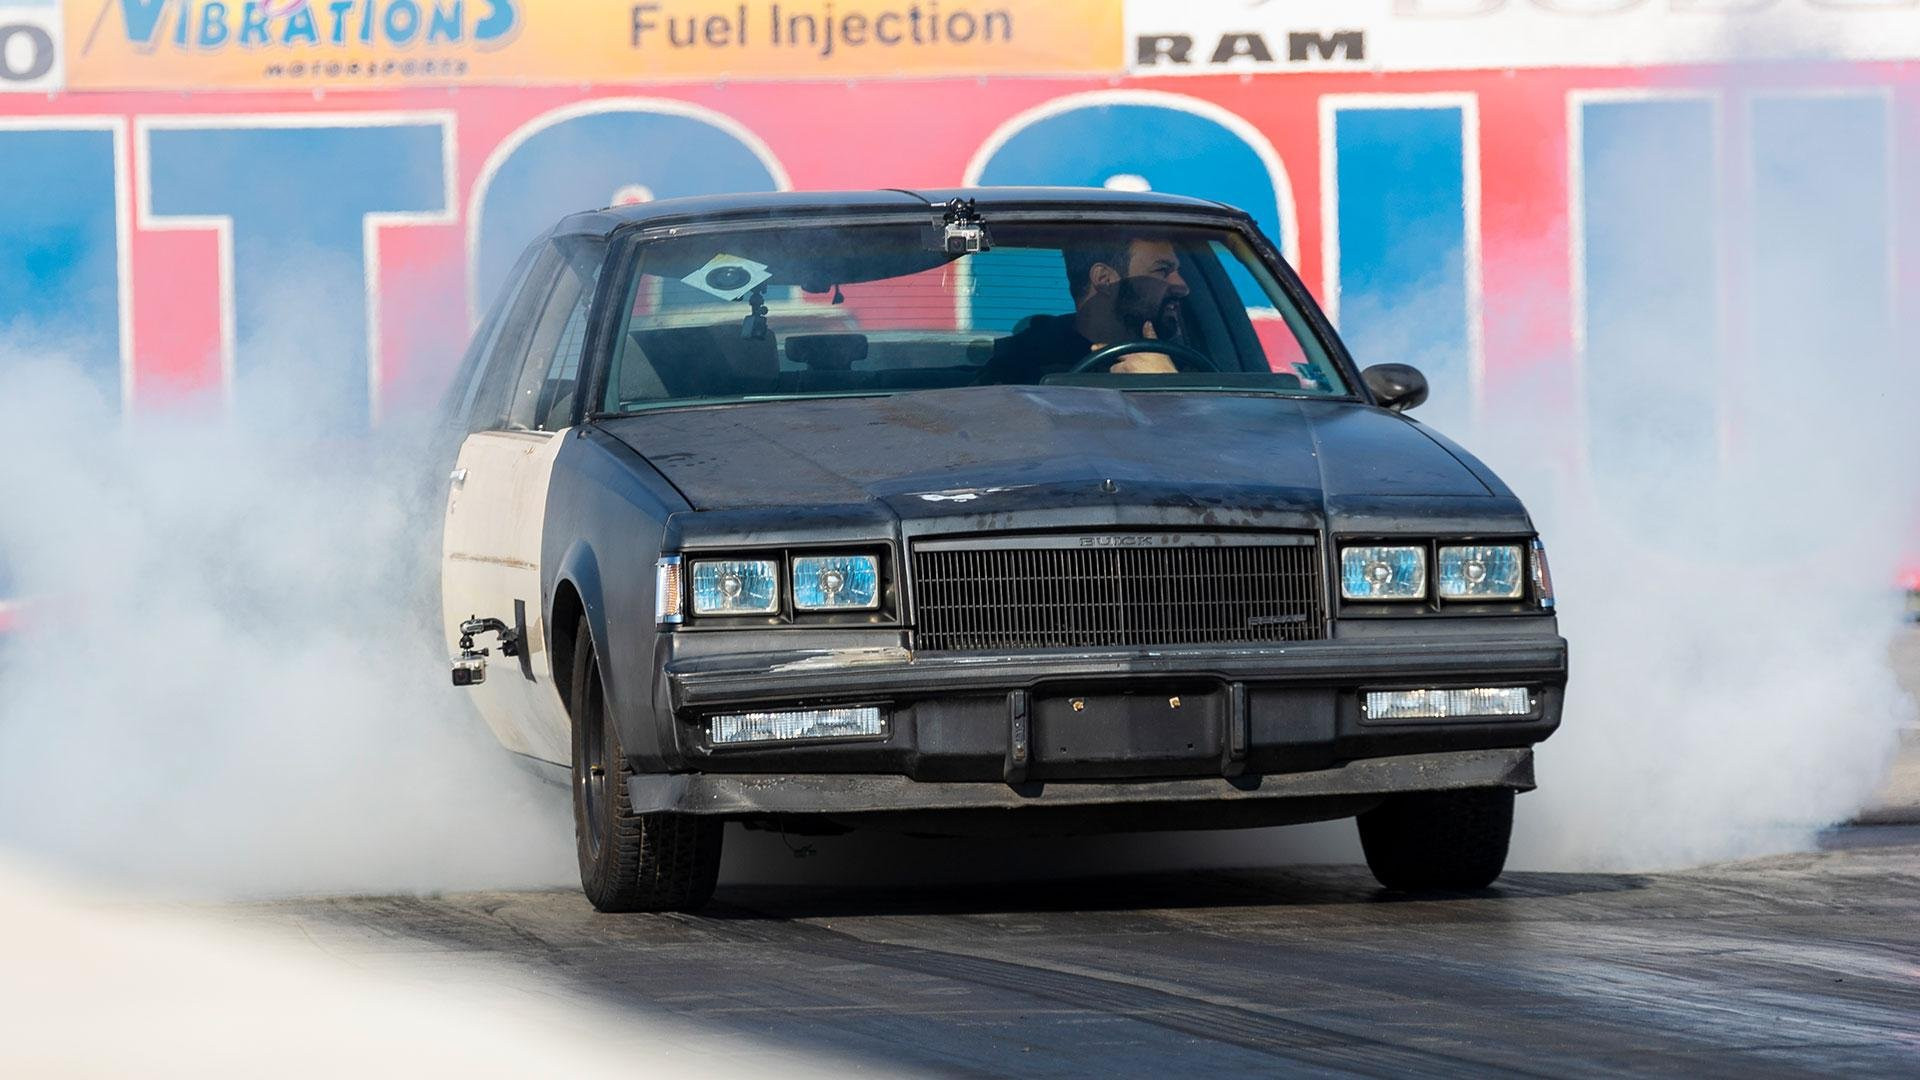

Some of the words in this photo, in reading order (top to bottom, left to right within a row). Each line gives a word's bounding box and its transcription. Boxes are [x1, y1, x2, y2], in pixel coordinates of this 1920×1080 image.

[632, 4, 747, 48] Fuel
[771, 1, 1013, 57] Injection
[1137, 31, 1365, 65] RAM
[1079, 535, 1153, 547] BUICK
